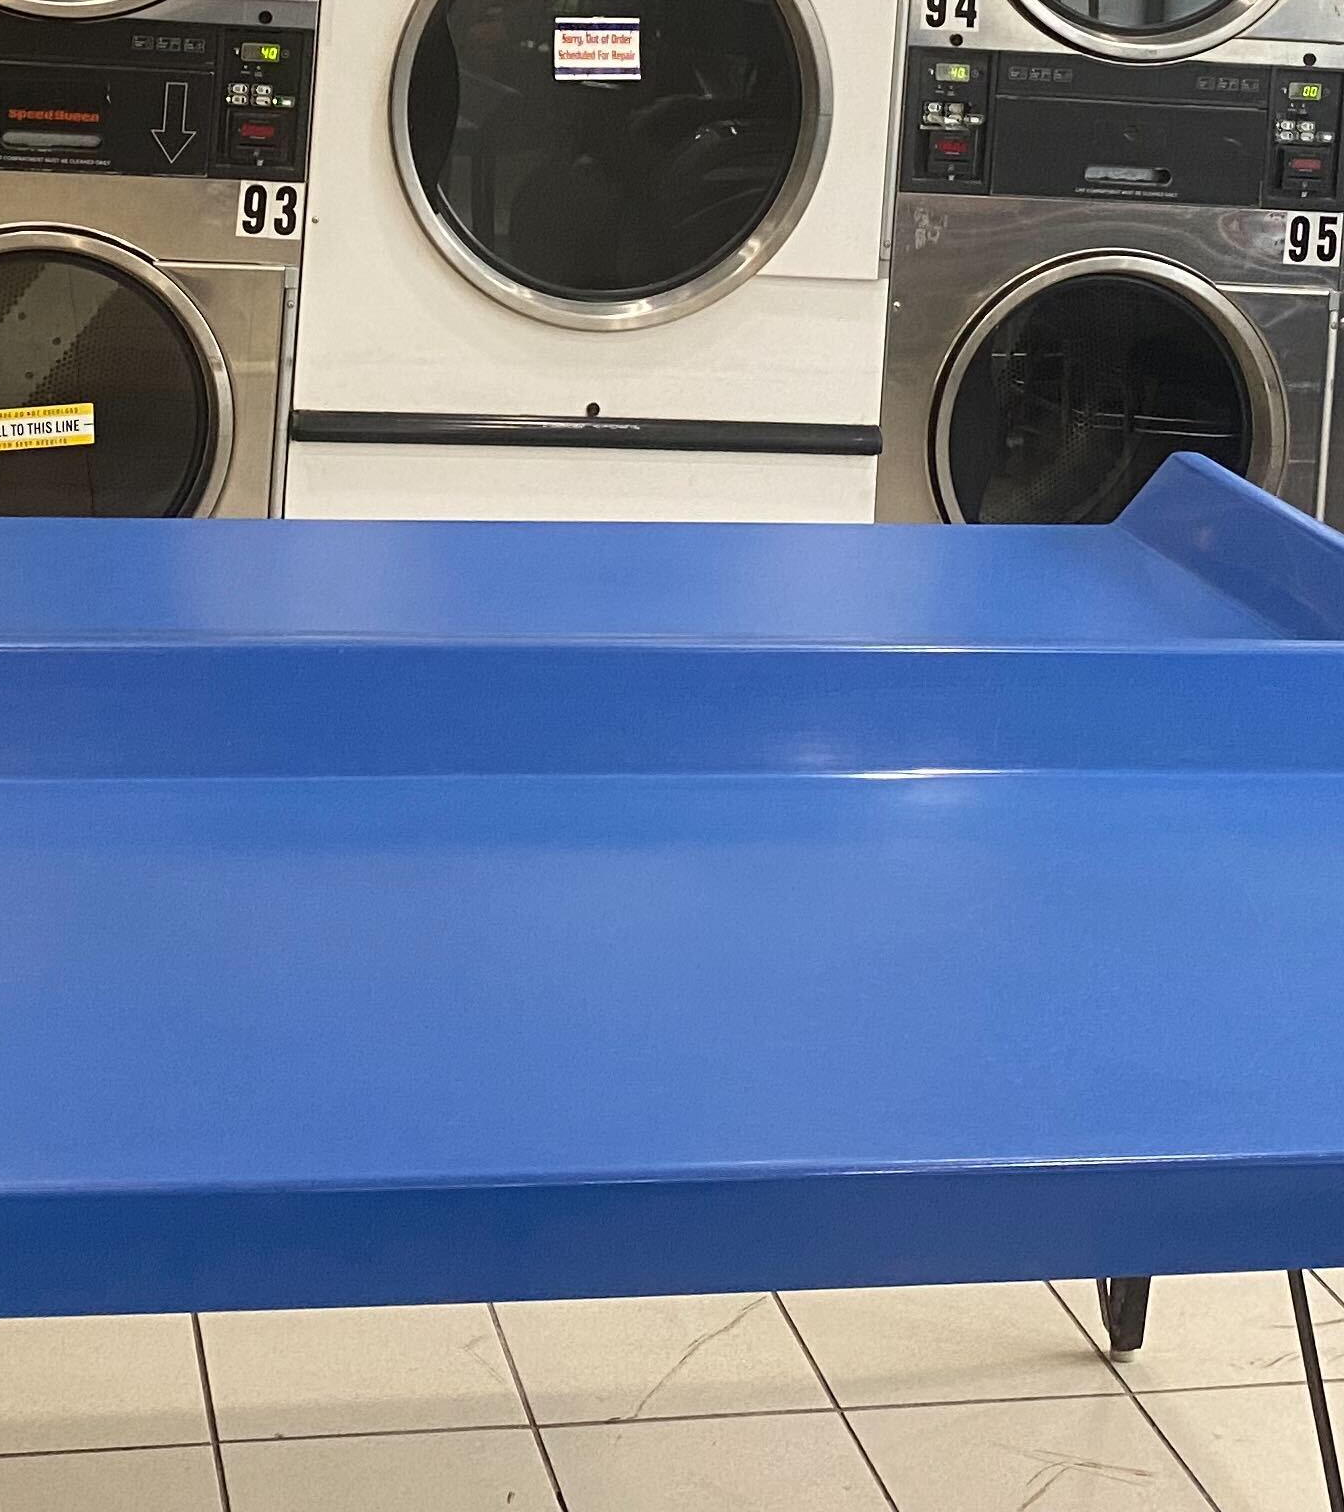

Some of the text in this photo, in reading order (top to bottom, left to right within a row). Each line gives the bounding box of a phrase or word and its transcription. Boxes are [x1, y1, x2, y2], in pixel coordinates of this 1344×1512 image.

[611, 34, 632, 44] Order
[260, 46, 278, 60] 40
[612, 50, 635, 62] Repair
[1302, 85, 1318, 97] 00
[242, 184, 298, 236] 93
[1288, 215, 1338, 262] 95
[10, 423, 24, 436] TO
[25, 421, 53, 435] THIS
[55, 419, 80, 433] LINE
